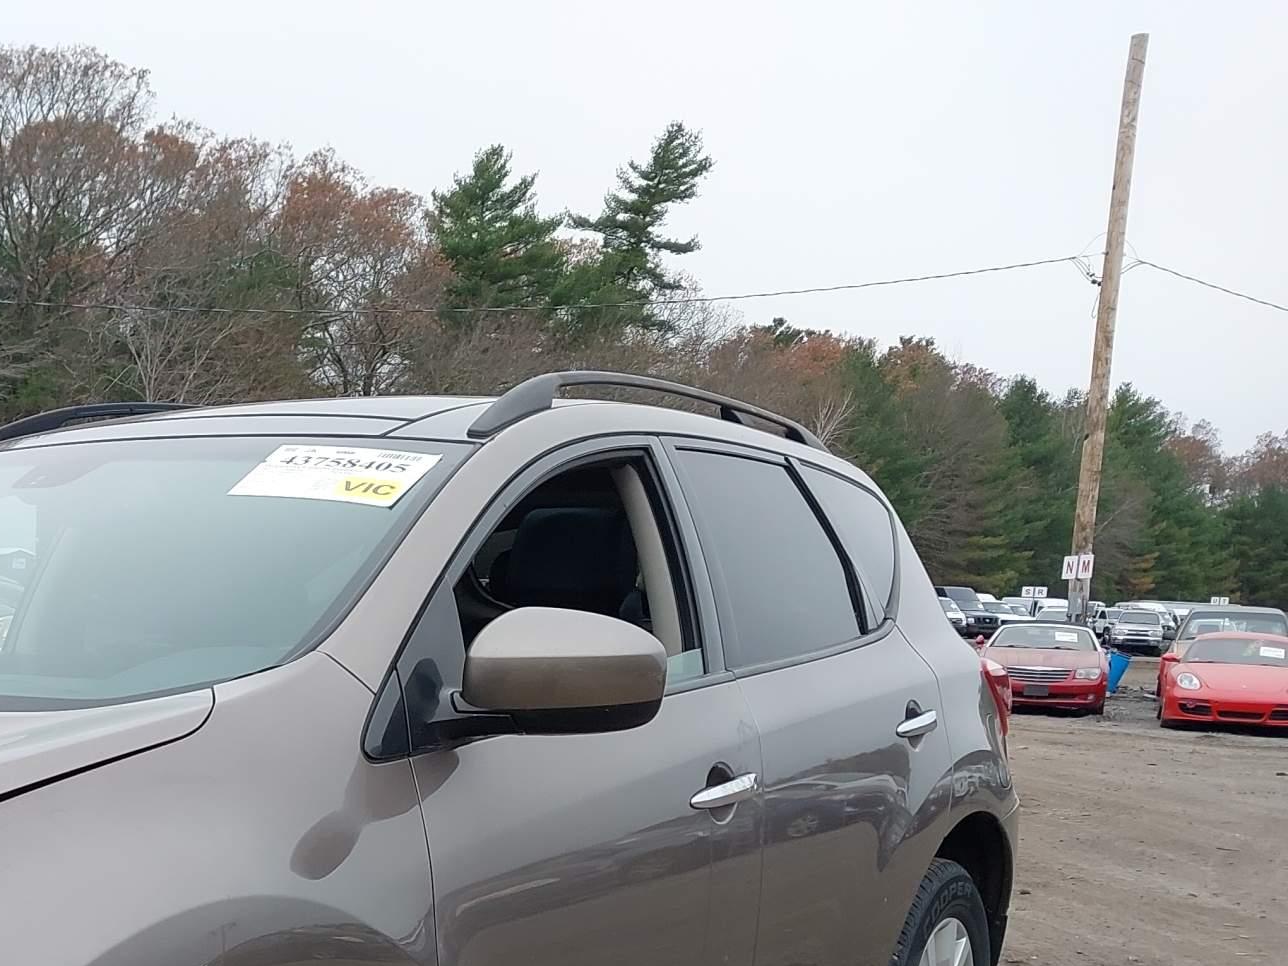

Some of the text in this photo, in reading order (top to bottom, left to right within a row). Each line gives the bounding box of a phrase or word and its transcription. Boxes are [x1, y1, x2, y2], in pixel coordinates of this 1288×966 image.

[280, 455, 412, 473] 43758405
[344, 480, 397, 496] VIC
[1065, 560, 1090, 574] N M
